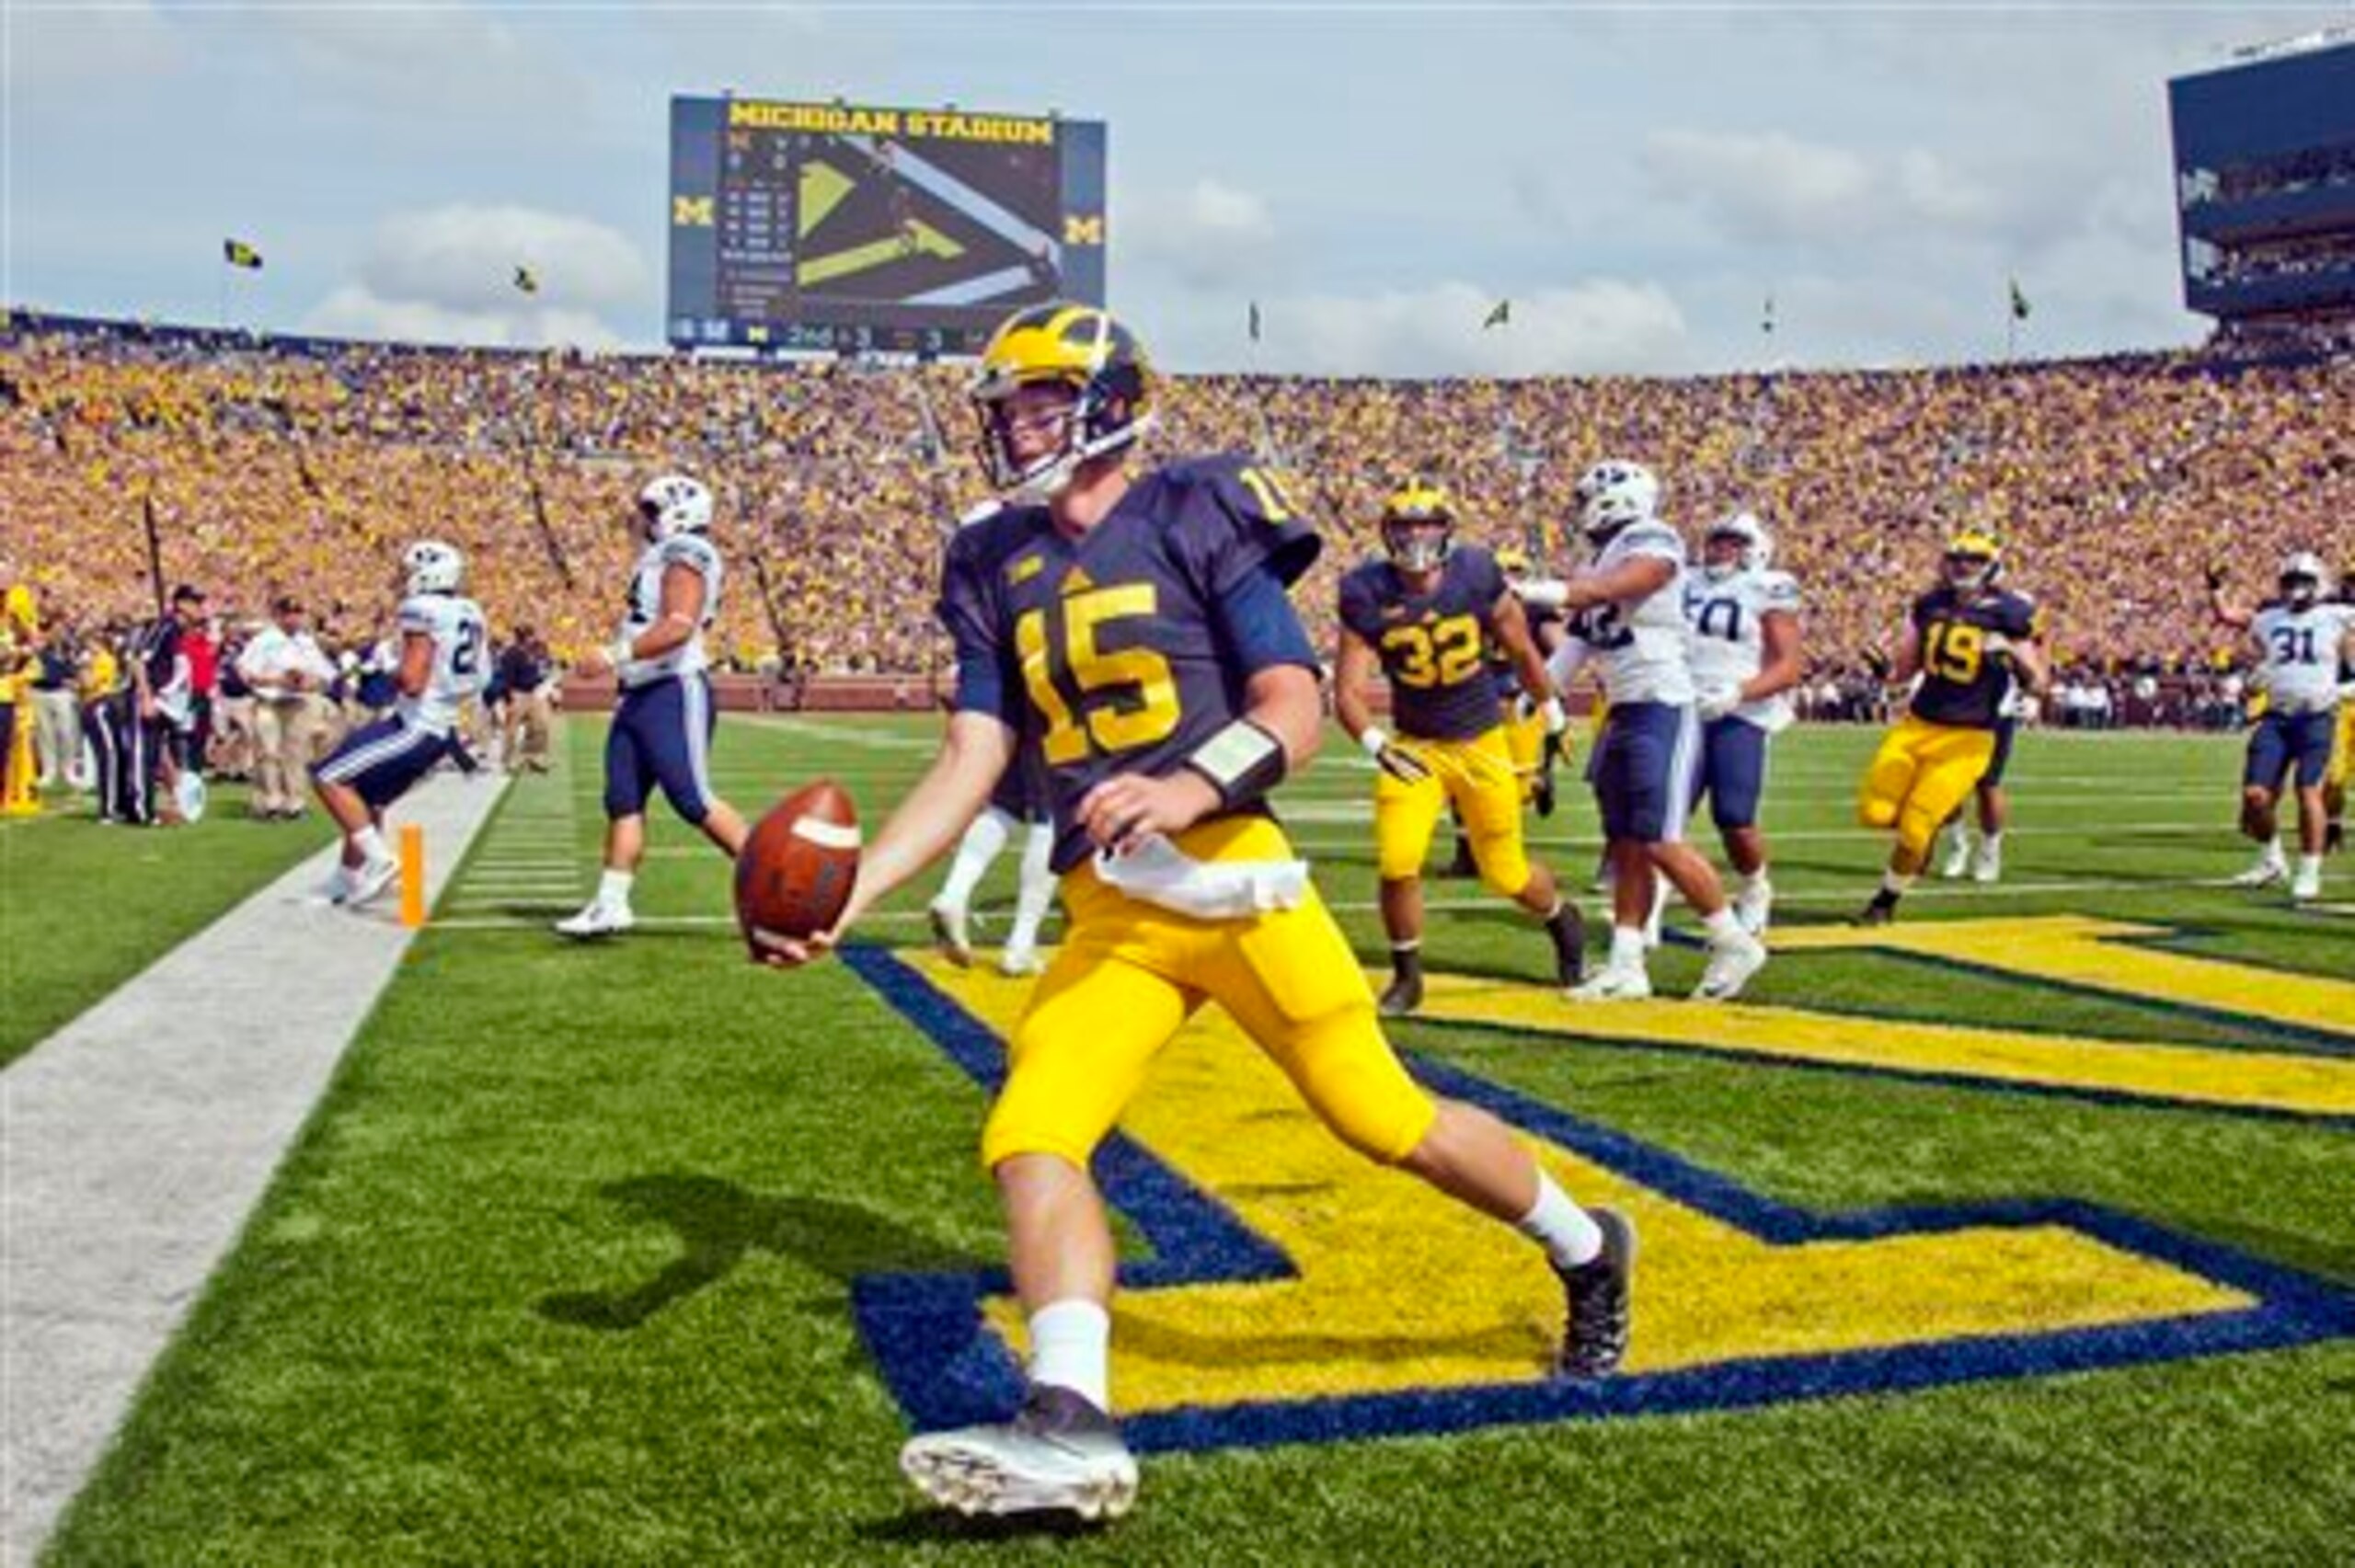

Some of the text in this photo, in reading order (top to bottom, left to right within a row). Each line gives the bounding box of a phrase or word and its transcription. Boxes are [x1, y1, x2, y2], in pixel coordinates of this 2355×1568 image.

[729, 101, 1052, 145] MICHIGAN STADIUM
[673, 195, 715, 225] M
[1063, 215, 1103, 245] M
[1383, 615, 1482, 689] 32
[1926, 621, 1983, 683] 19
[2271, 626, 2318, 667] 31
[1016, 582, 1181, 767] 15
